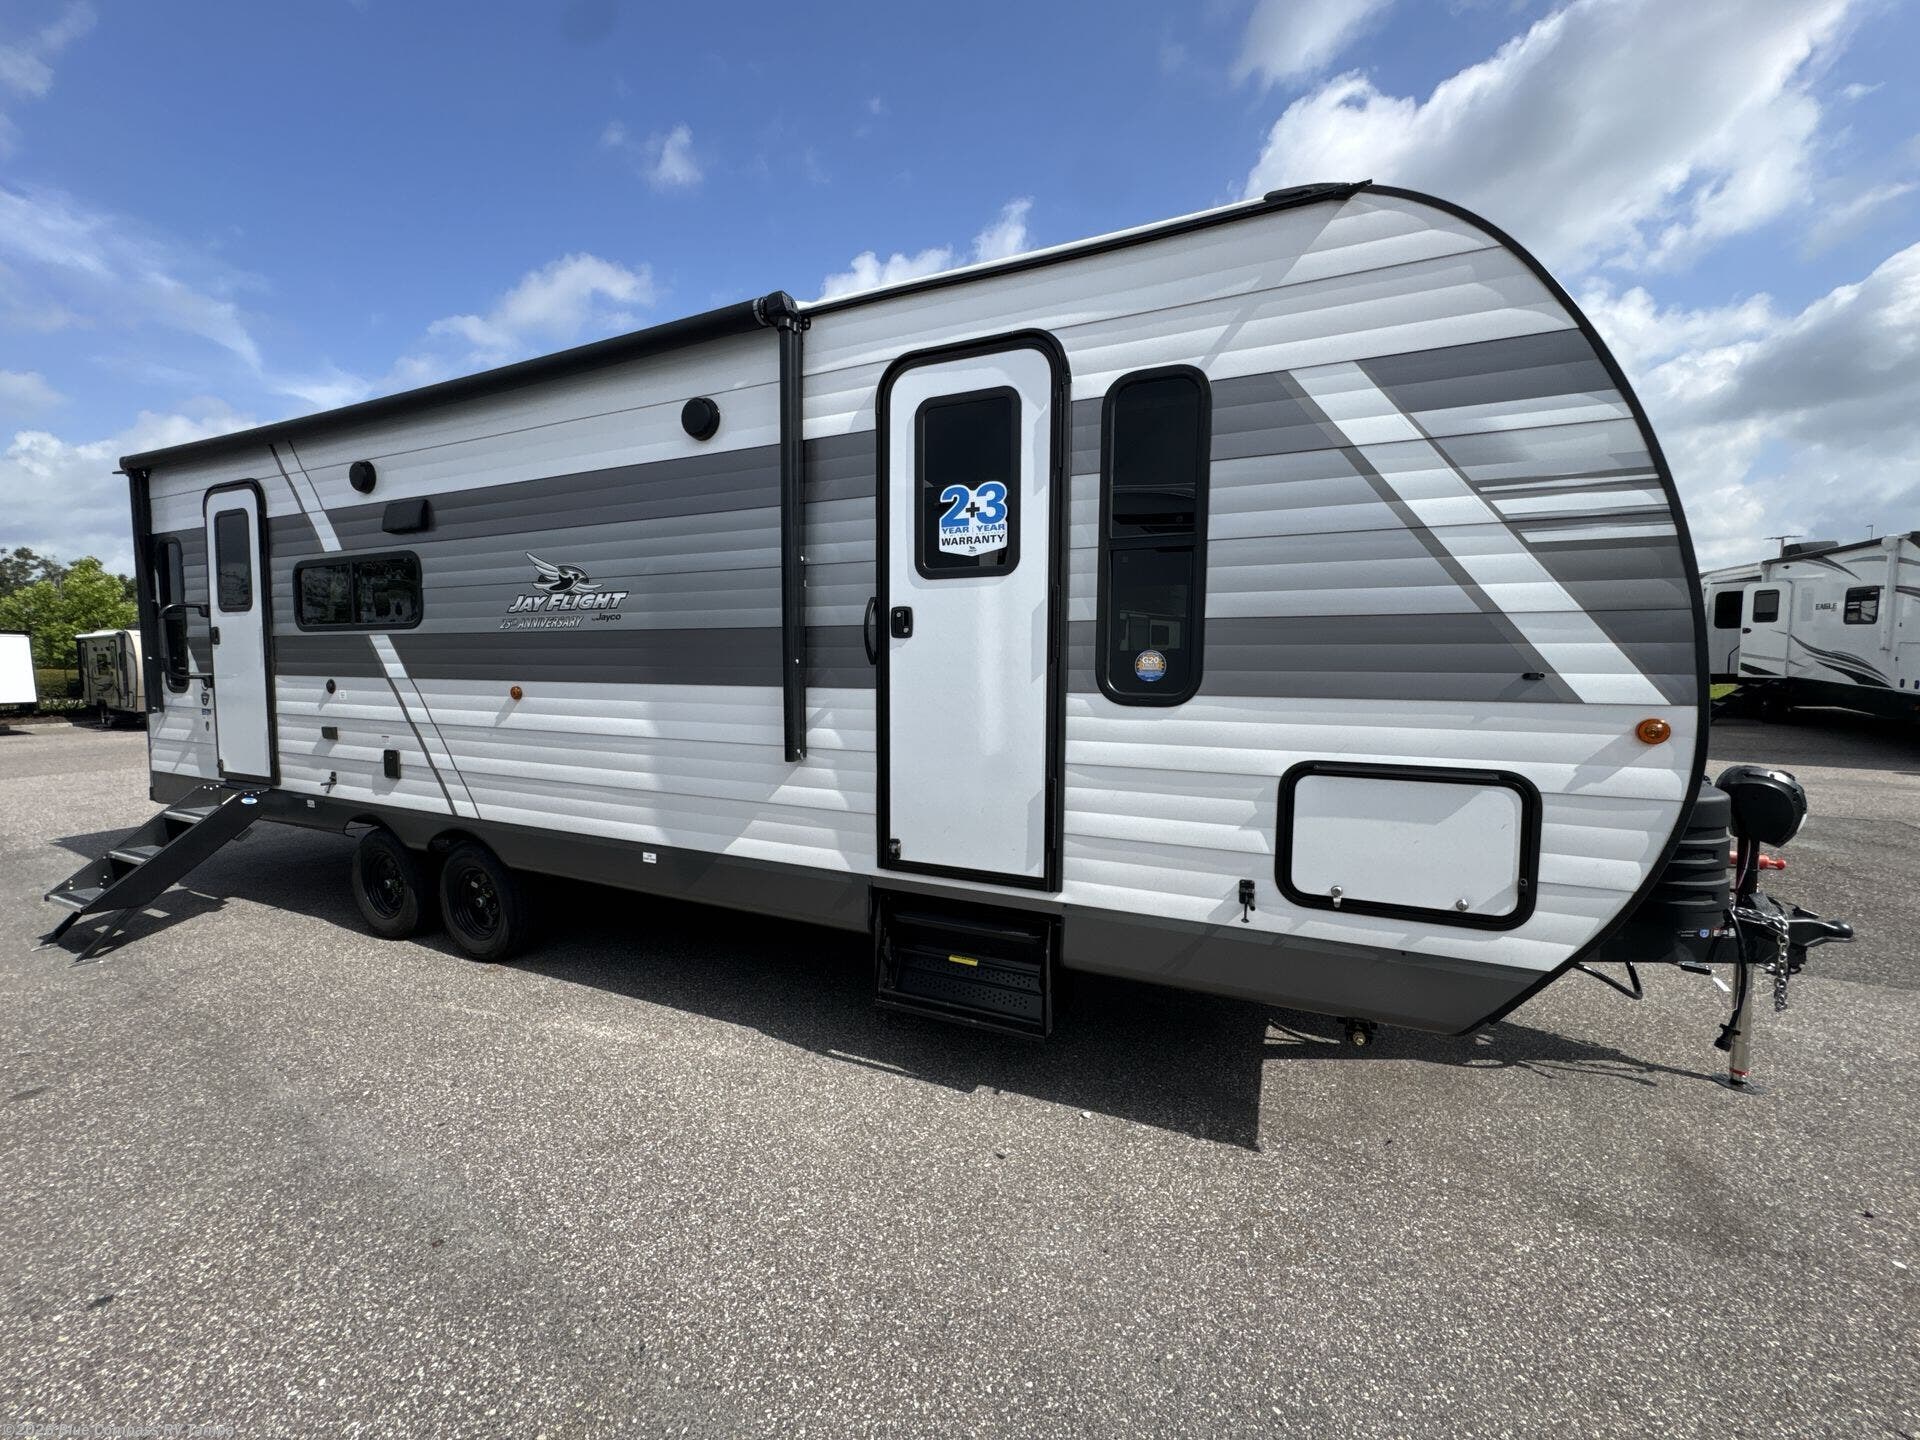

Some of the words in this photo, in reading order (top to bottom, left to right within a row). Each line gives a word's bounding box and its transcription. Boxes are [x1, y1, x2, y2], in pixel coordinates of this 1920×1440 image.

[941, 534, 1005, 546] WARRANTY
[507, 594, 547, 613] JAY
[546, 591, 629, 612] FLIGHT
[517, 615, 584, 630] ANNIVERSARY
